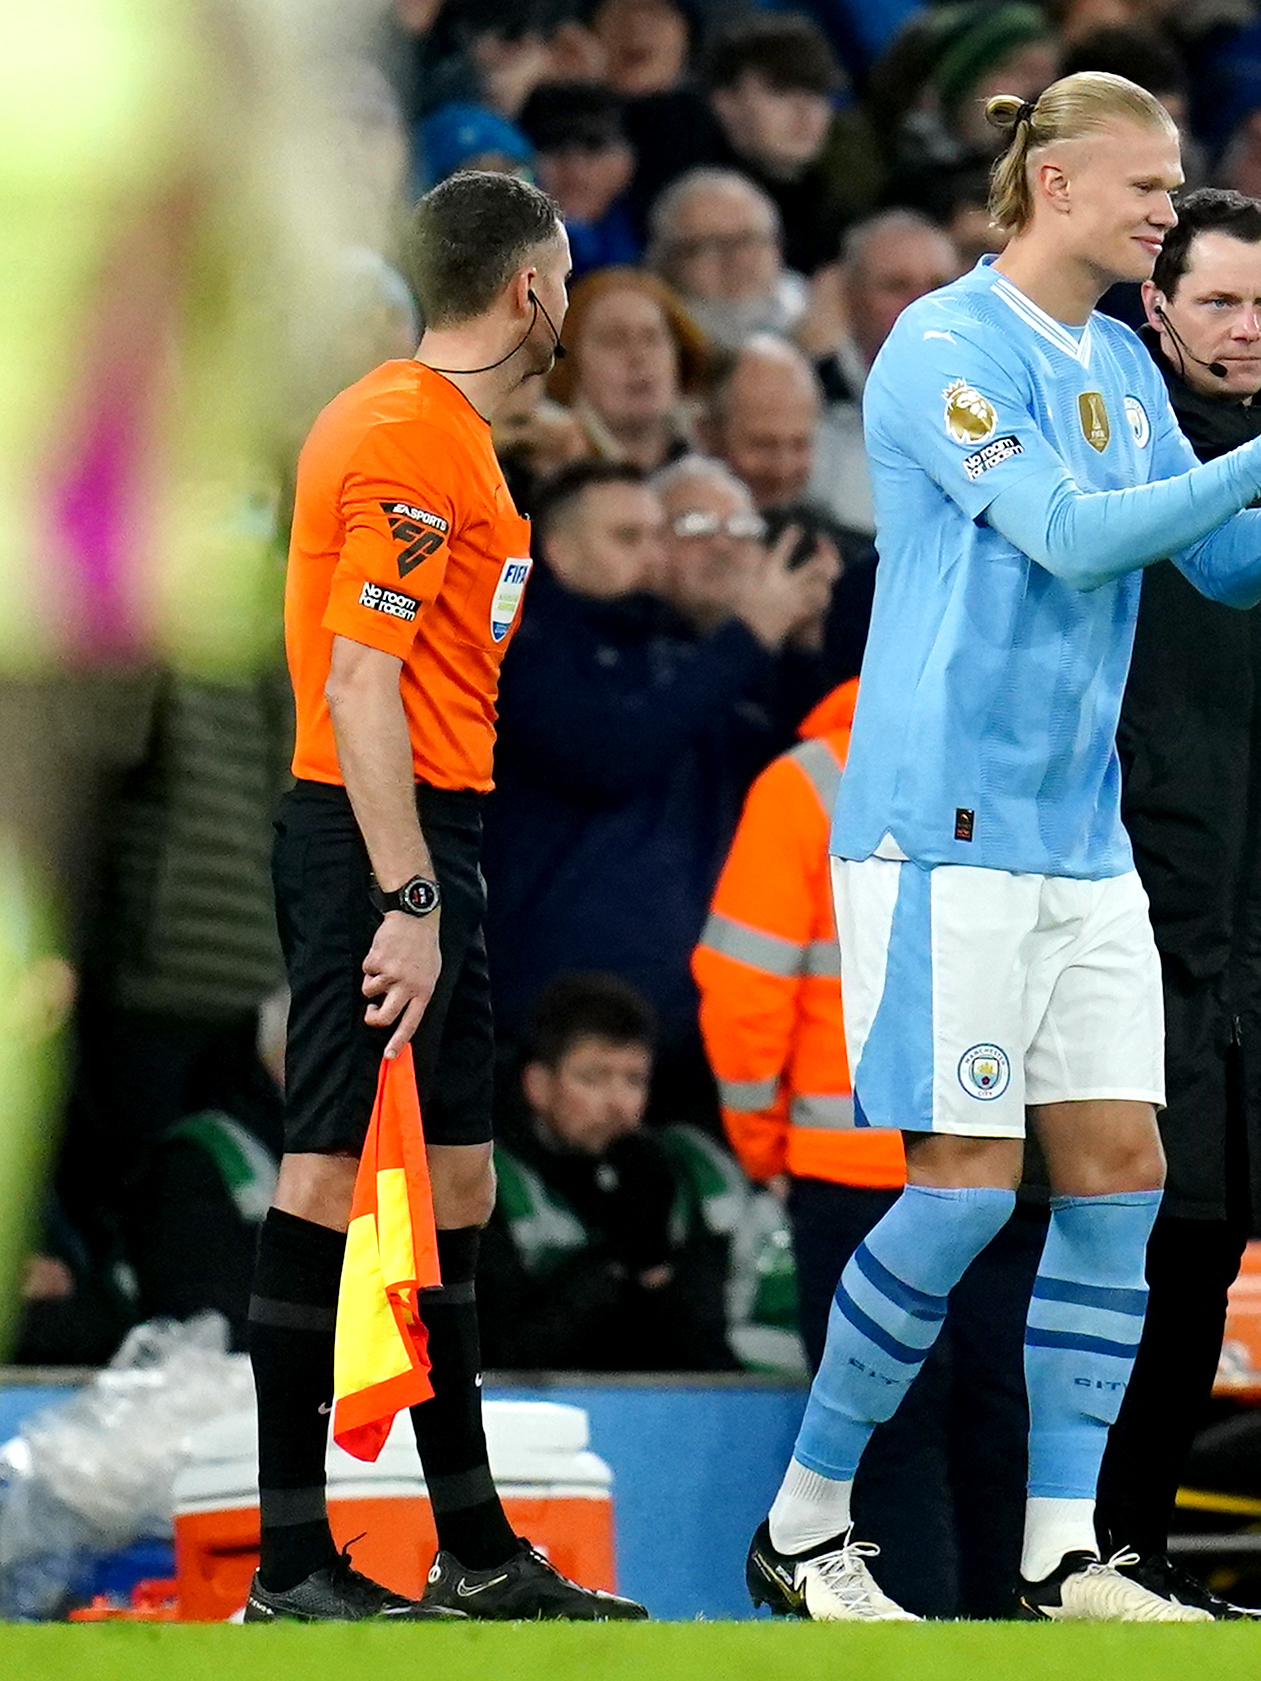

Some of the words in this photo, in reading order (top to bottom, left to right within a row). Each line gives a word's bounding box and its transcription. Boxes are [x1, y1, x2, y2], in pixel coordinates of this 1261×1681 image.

[963, 454, 981, 470] No
[980, 438, 1014, 461] room
[966, 463, 985, 480] for
[393, 503, 411, 517] EA
[410, 507, 447, 532] SPORTS
[504, 564, 528, 584] FIFA
[359, 595, 379, 609] for
[363, 581, 383, 598] No
[383, 590, 416, 610] room
[964, 1047, 1005, 1066] MANCHESTER
[849, 1357, 914, 1385] CIT
